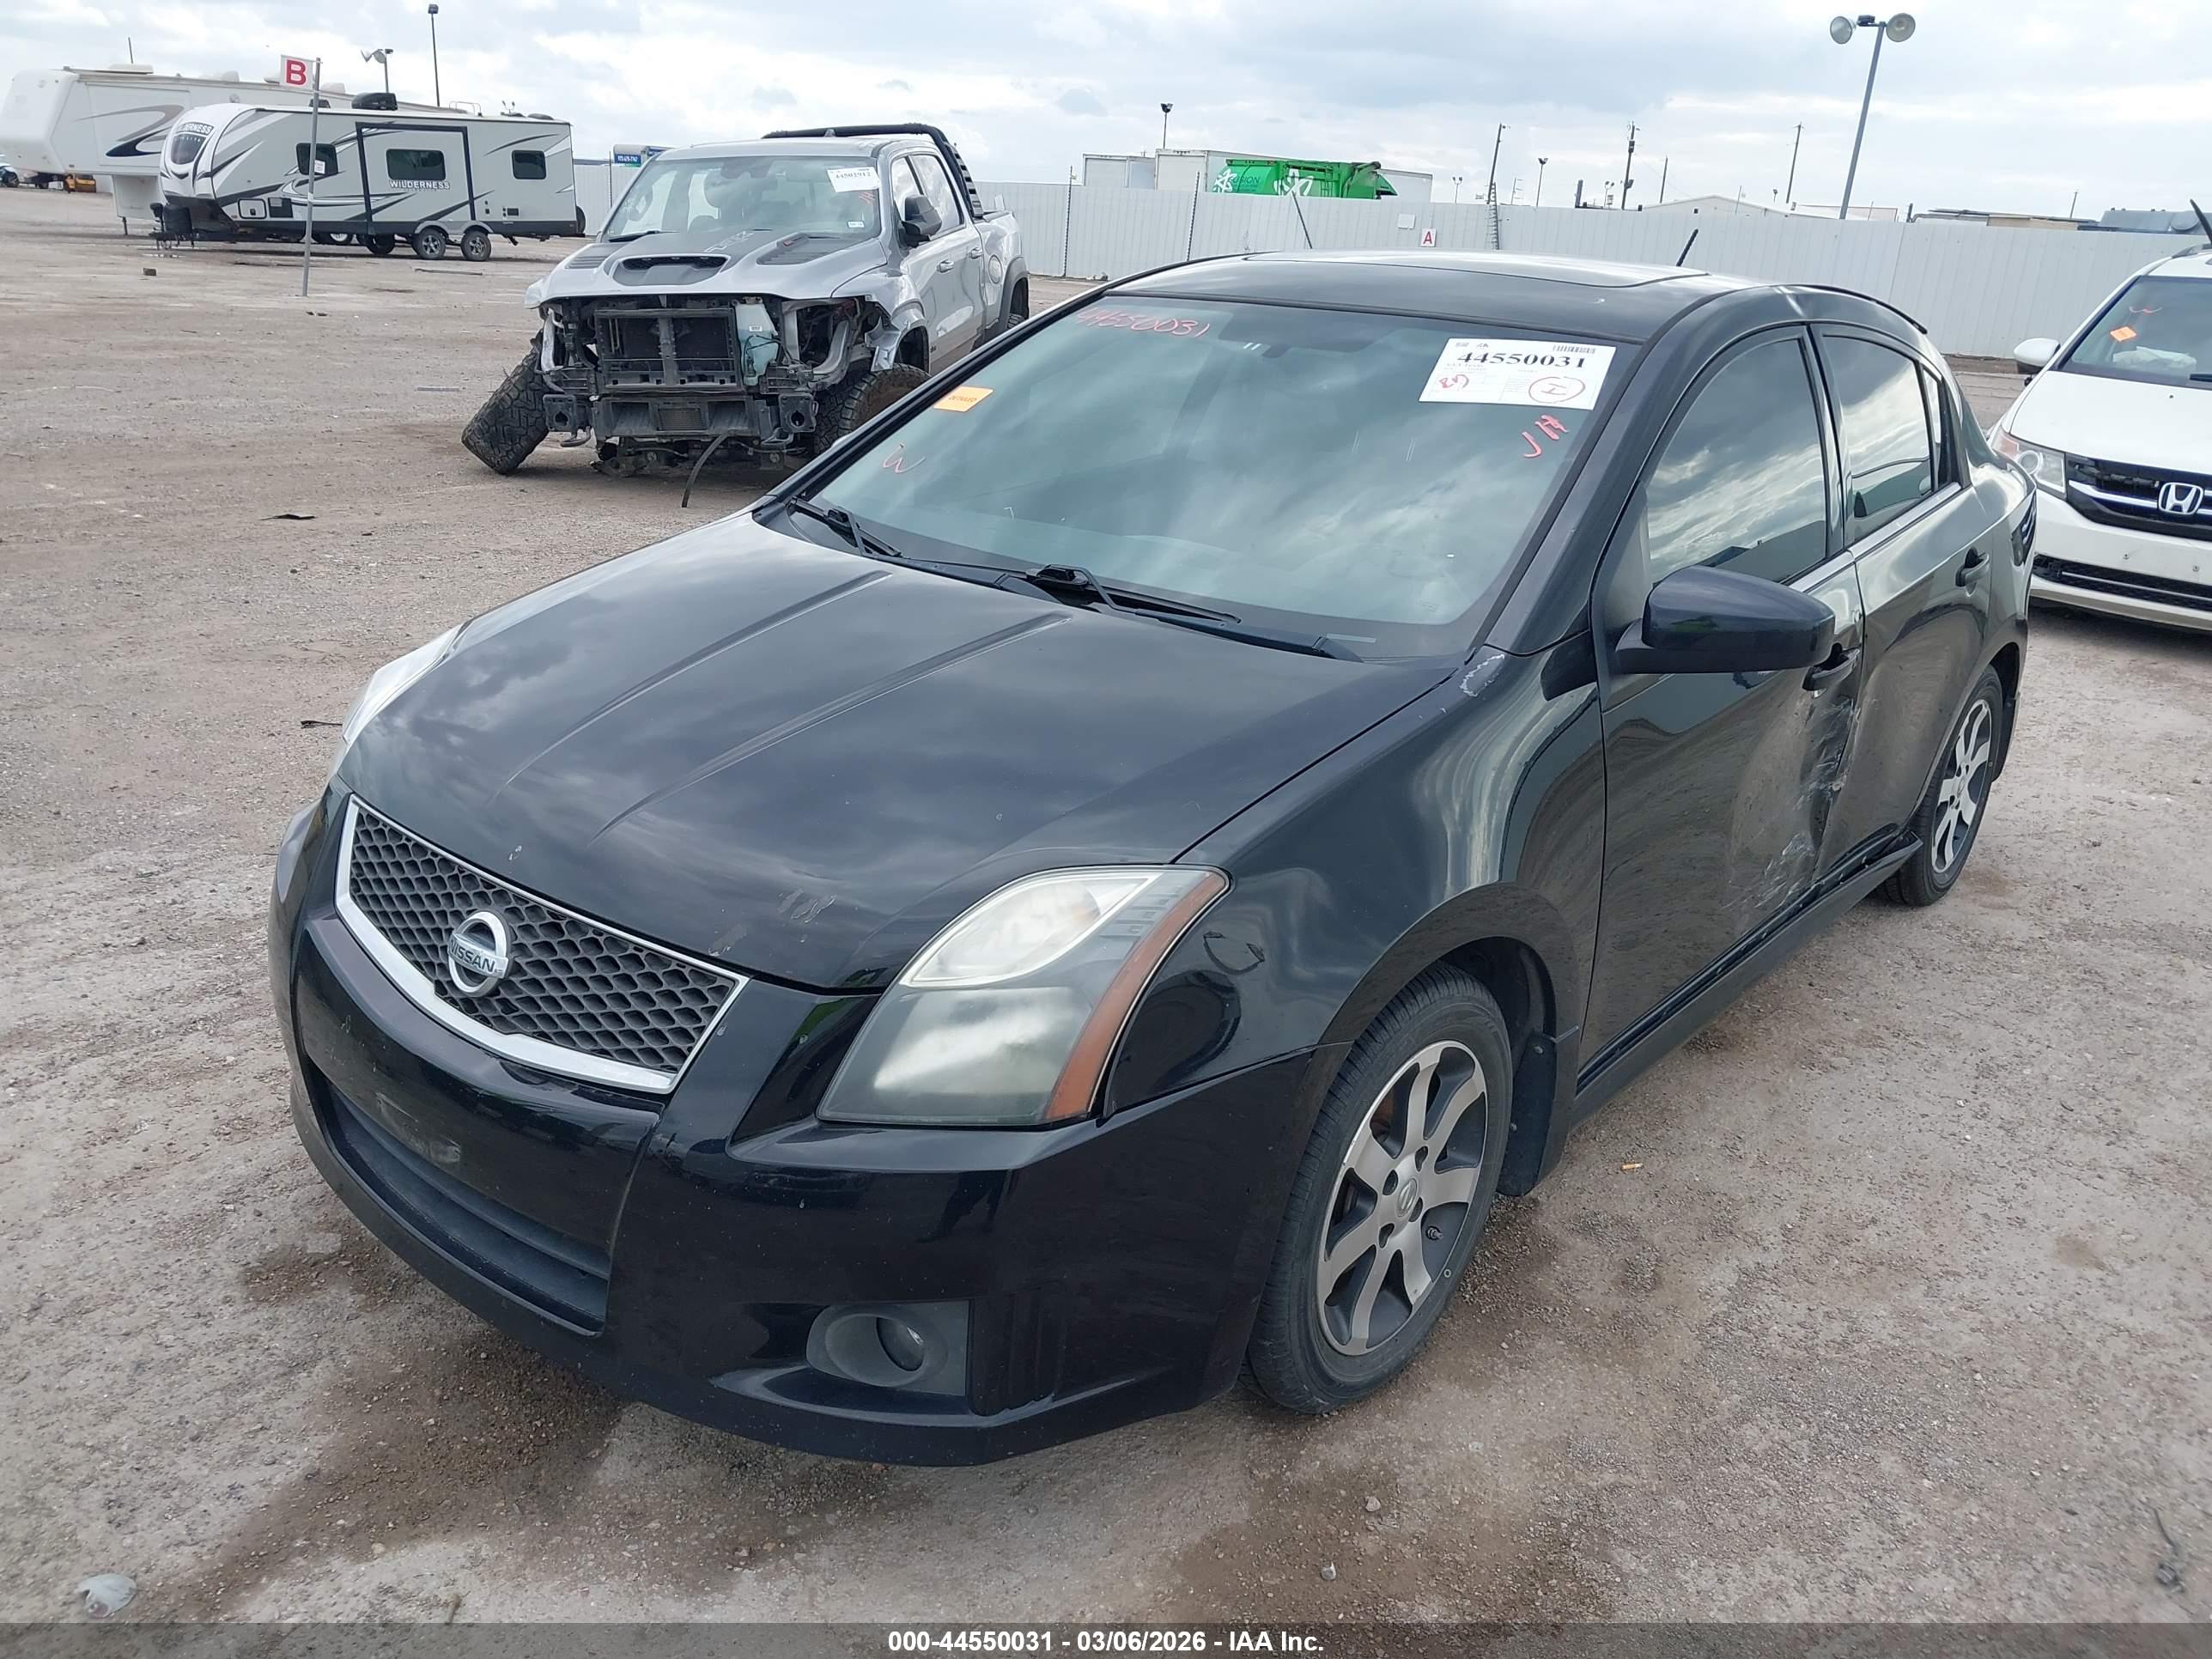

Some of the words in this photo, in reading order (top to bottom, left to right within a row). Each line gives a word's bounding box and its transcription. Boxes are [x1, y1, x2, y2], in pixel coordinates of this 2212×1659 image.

[286, 59, 307, 85] B
[390, 179, 451, 190] WILDERNESS
[1423, 230, 1432, 245] A
[1456, 351, 1587, 369] 44550031
[449, 939, 495, 973] NISSAN
